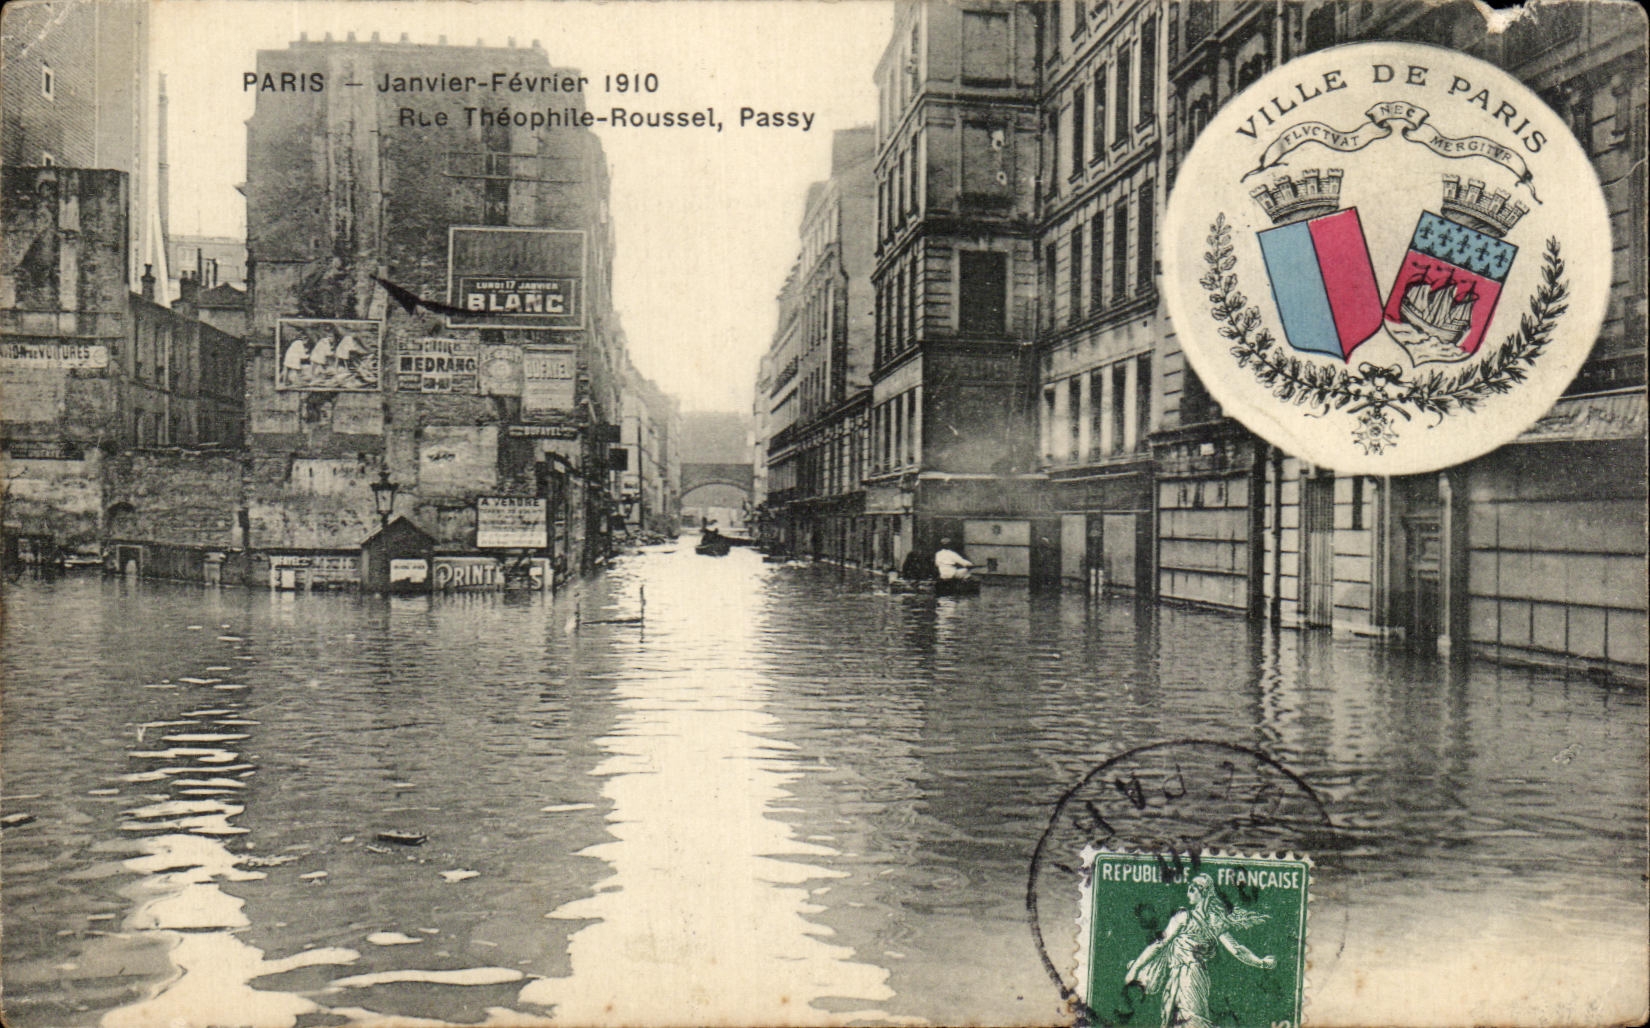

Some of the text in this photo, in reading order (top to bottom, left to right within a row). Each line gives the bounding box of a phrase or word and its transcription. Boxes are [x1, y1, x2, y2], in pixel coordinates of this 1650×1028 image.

[506, 280, 516, 290] 17
[467, 293, 564, 313] BLANC
[1102, 862, 1300, 890] REPUBLIUE FRANÇAISE
